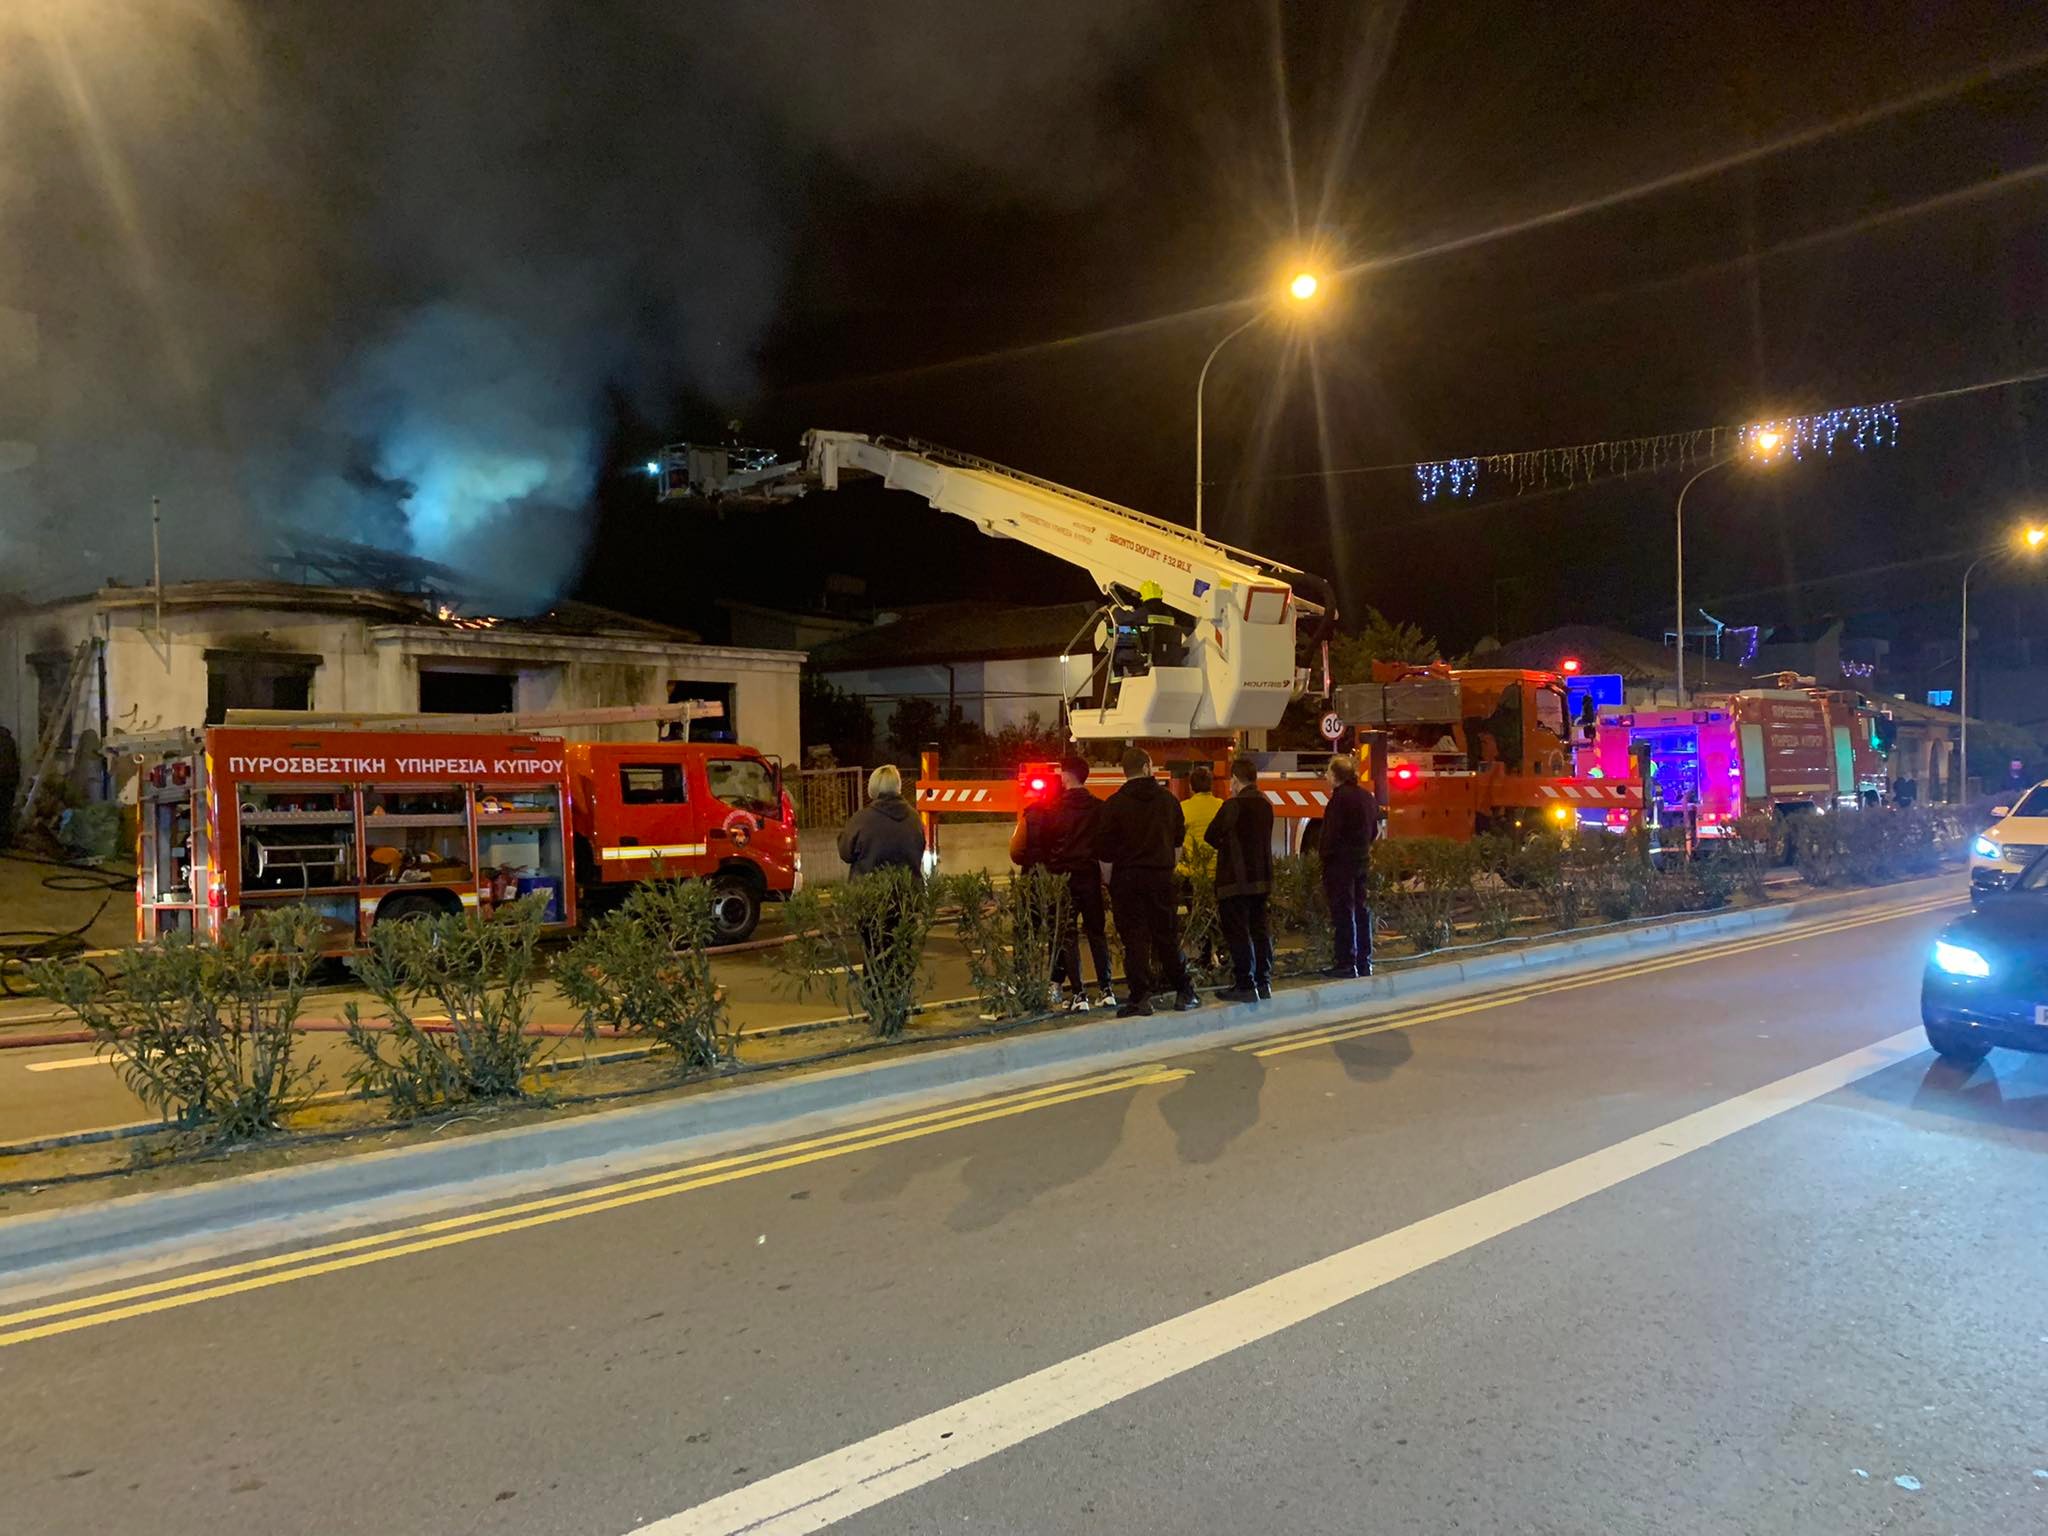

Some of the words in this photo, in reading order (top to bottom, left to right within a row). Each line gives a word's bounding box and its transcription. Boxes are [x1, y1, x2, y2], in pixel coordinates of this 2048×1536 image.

[1109, 533, 1134, 550] BRONTO
[1135, 543, 1160, 560] SKYLIFT
[1168, 556, 1176, 567] 32
[1325, 718, 1342, 733] 30
[229, 756, 385, 774] ΠΥΡΟΣΒΕΣΤΙΚΗ
[395, 758, 487, 774] ΥΠΗΡΕΣΙΑ
[494, 759, 564, 774] ΚΥΠΡΟΥ
